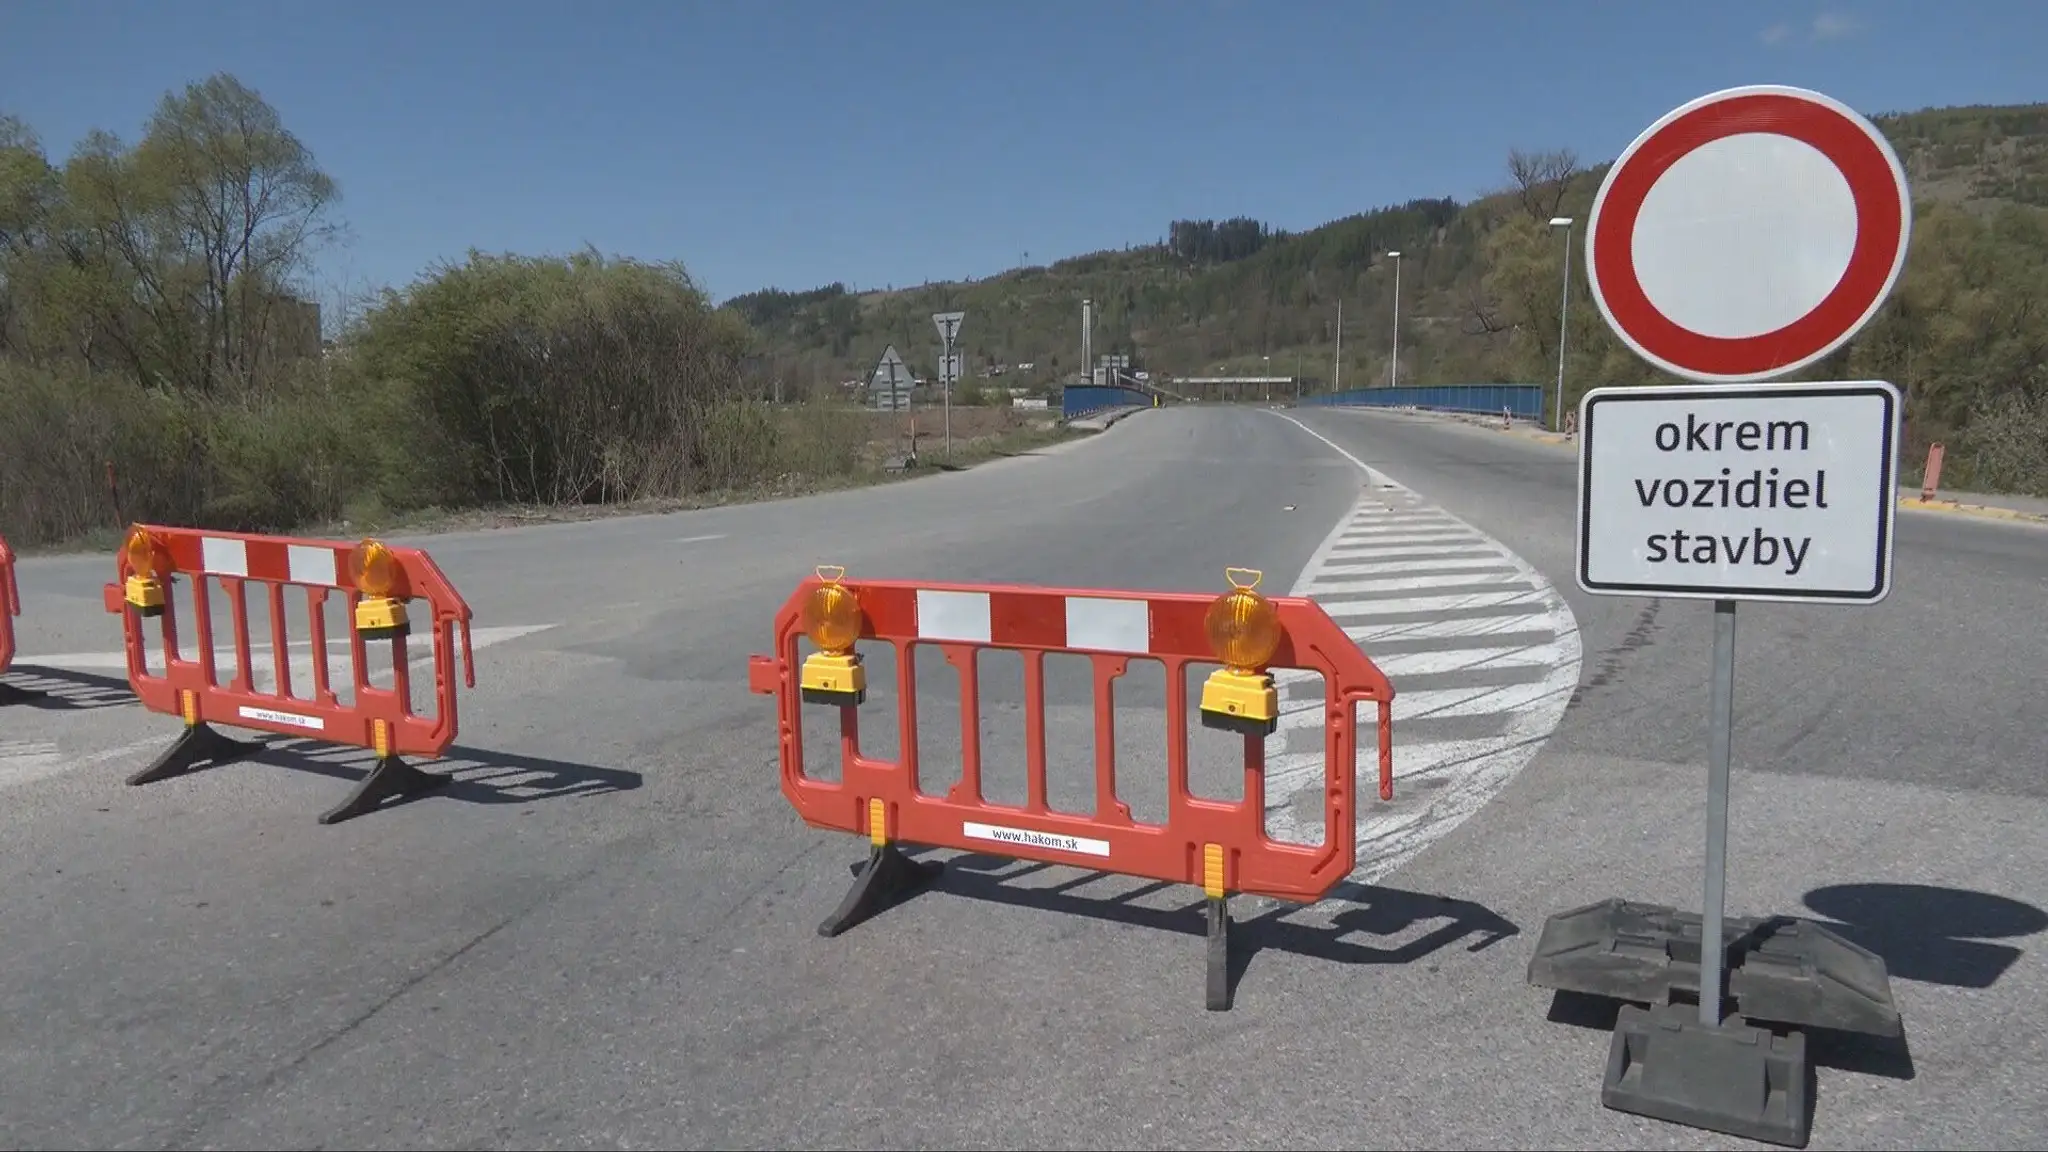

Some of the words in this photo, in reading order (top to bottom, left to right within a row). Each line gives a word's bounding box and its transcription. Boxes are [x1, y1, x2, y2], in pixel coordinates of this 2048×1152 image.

[1655, 413, 1810, 452] okrem
[1634, 467, 1828, 509] vozidiel
[1646, 527, 1811, 575] stavby
[992, 829, 1079, 850] www.hakom.sk
